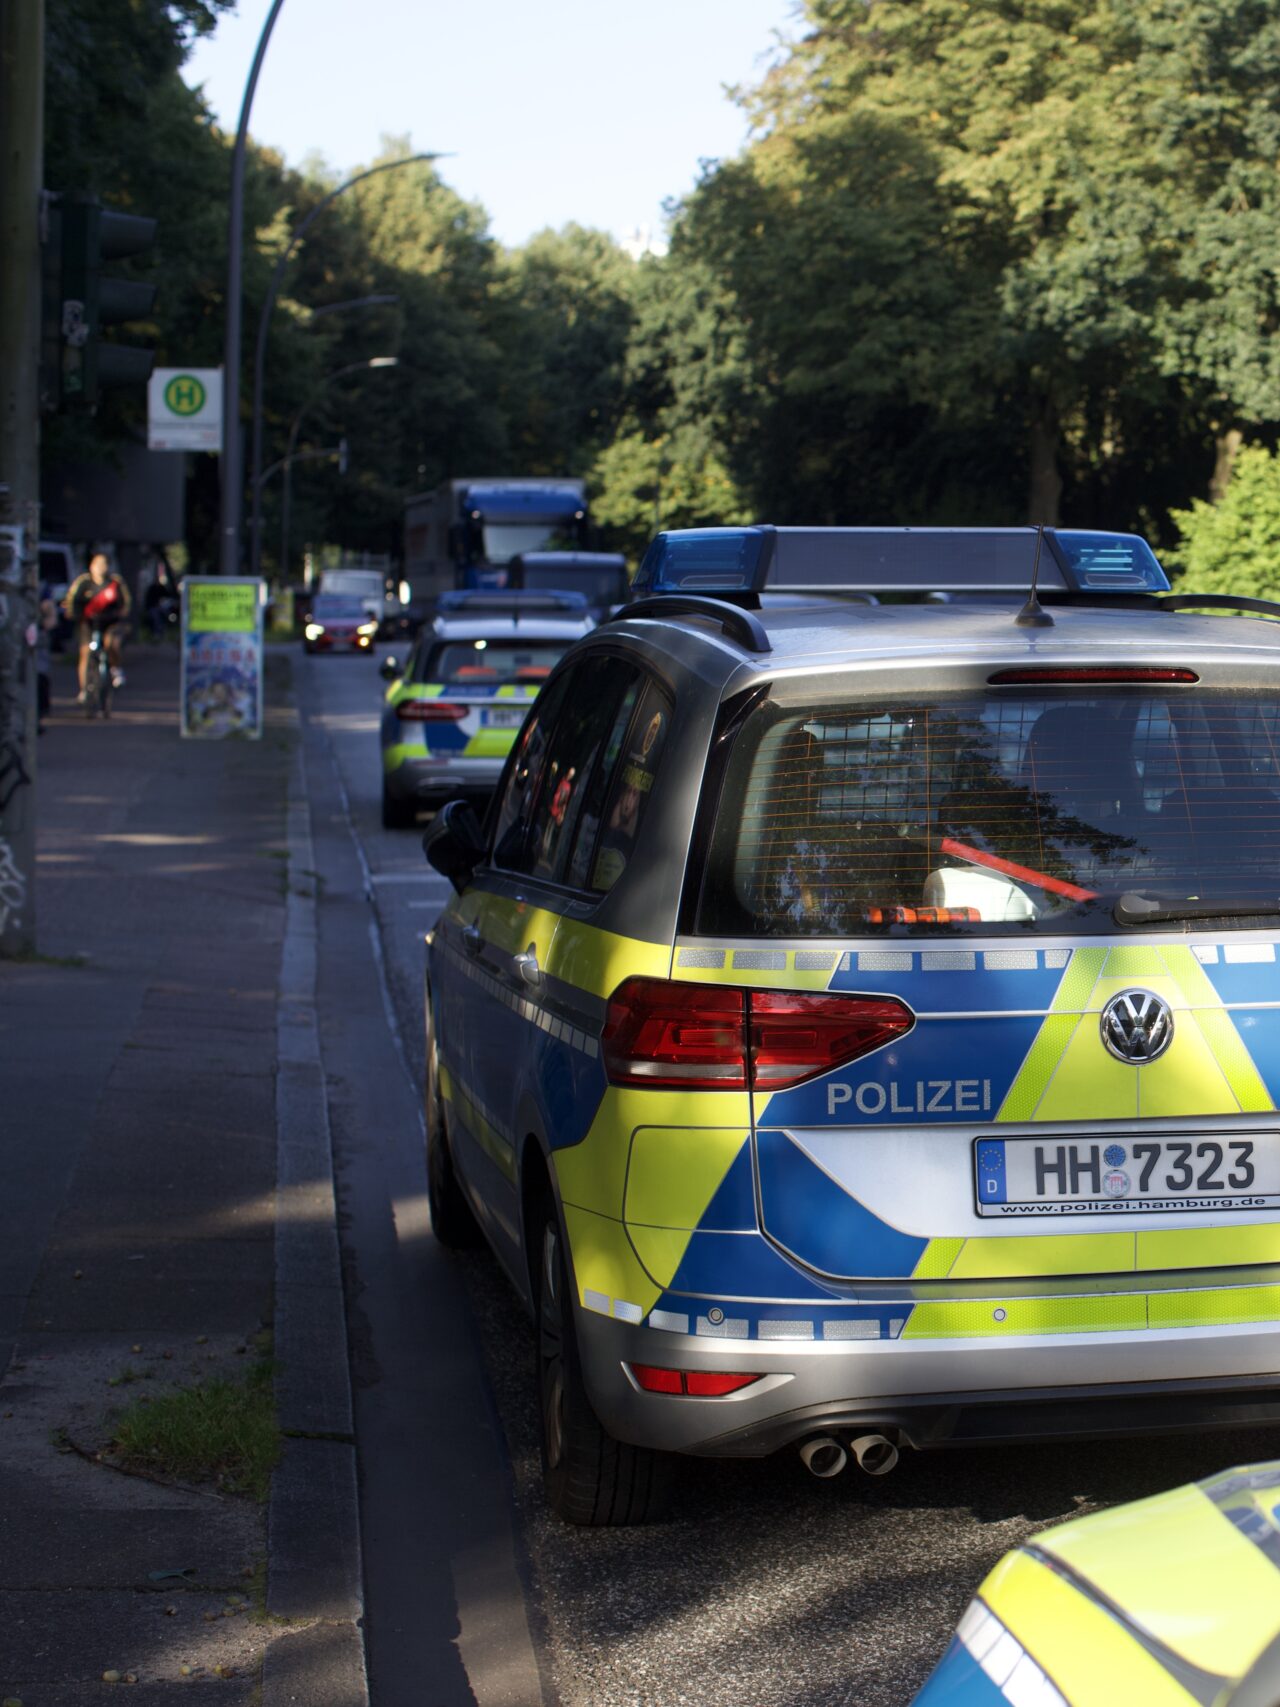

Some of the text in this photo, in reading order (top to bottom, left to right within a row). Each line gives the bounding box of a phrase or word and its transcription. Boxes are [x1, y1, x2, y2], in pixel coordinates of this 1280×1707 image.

[827, 1079, 991, 1115] POLIZEI
[1035, 1141, 1255, 1195] HH 7323
[987, 1180, 998, 1193] D
[1001, 1196, 1266, 1213] www.polizei.hamburg.de
